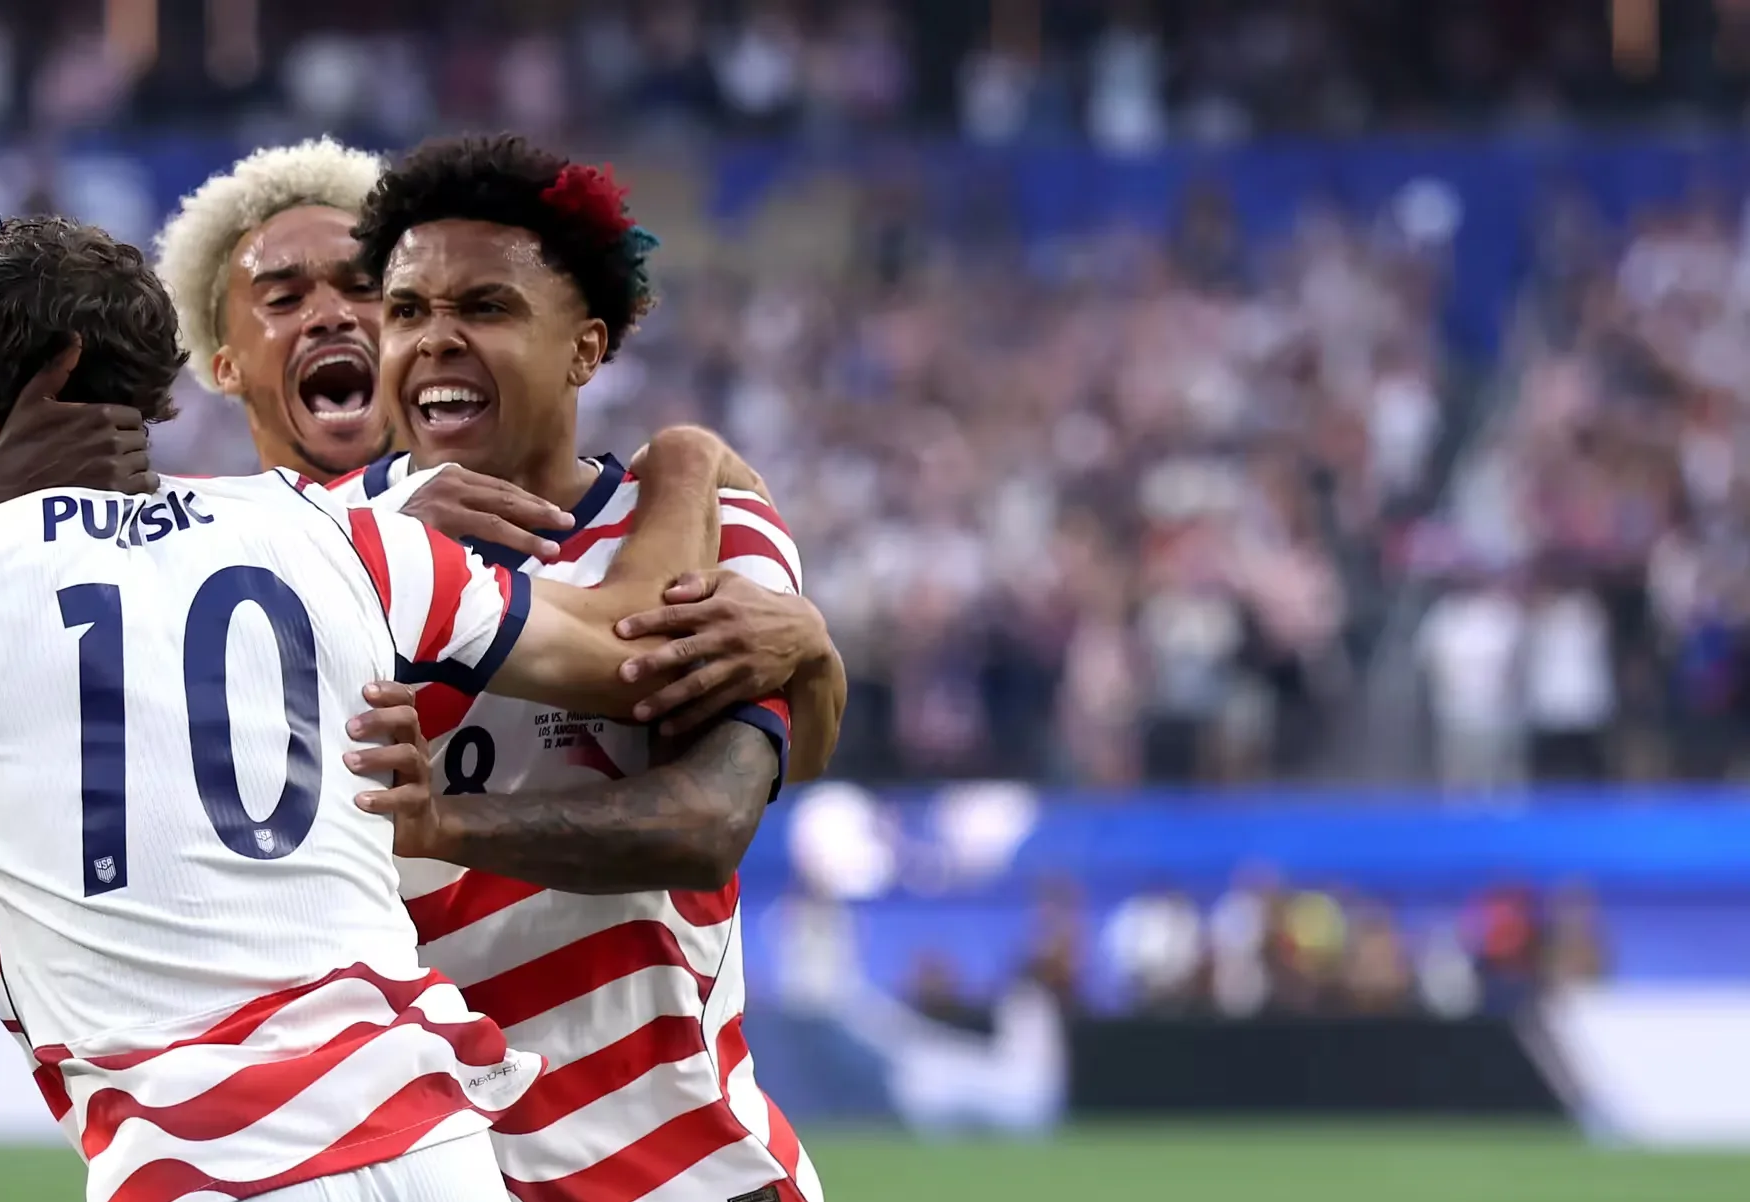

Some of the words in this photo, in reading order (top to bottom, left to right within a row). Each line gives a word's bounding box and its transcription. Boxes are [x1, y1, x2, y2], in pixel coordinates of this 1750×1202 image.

[56, 565, 322, 897] 10
[534, 714, 549, 725] USA
[443, 726, 495, 796] 8
